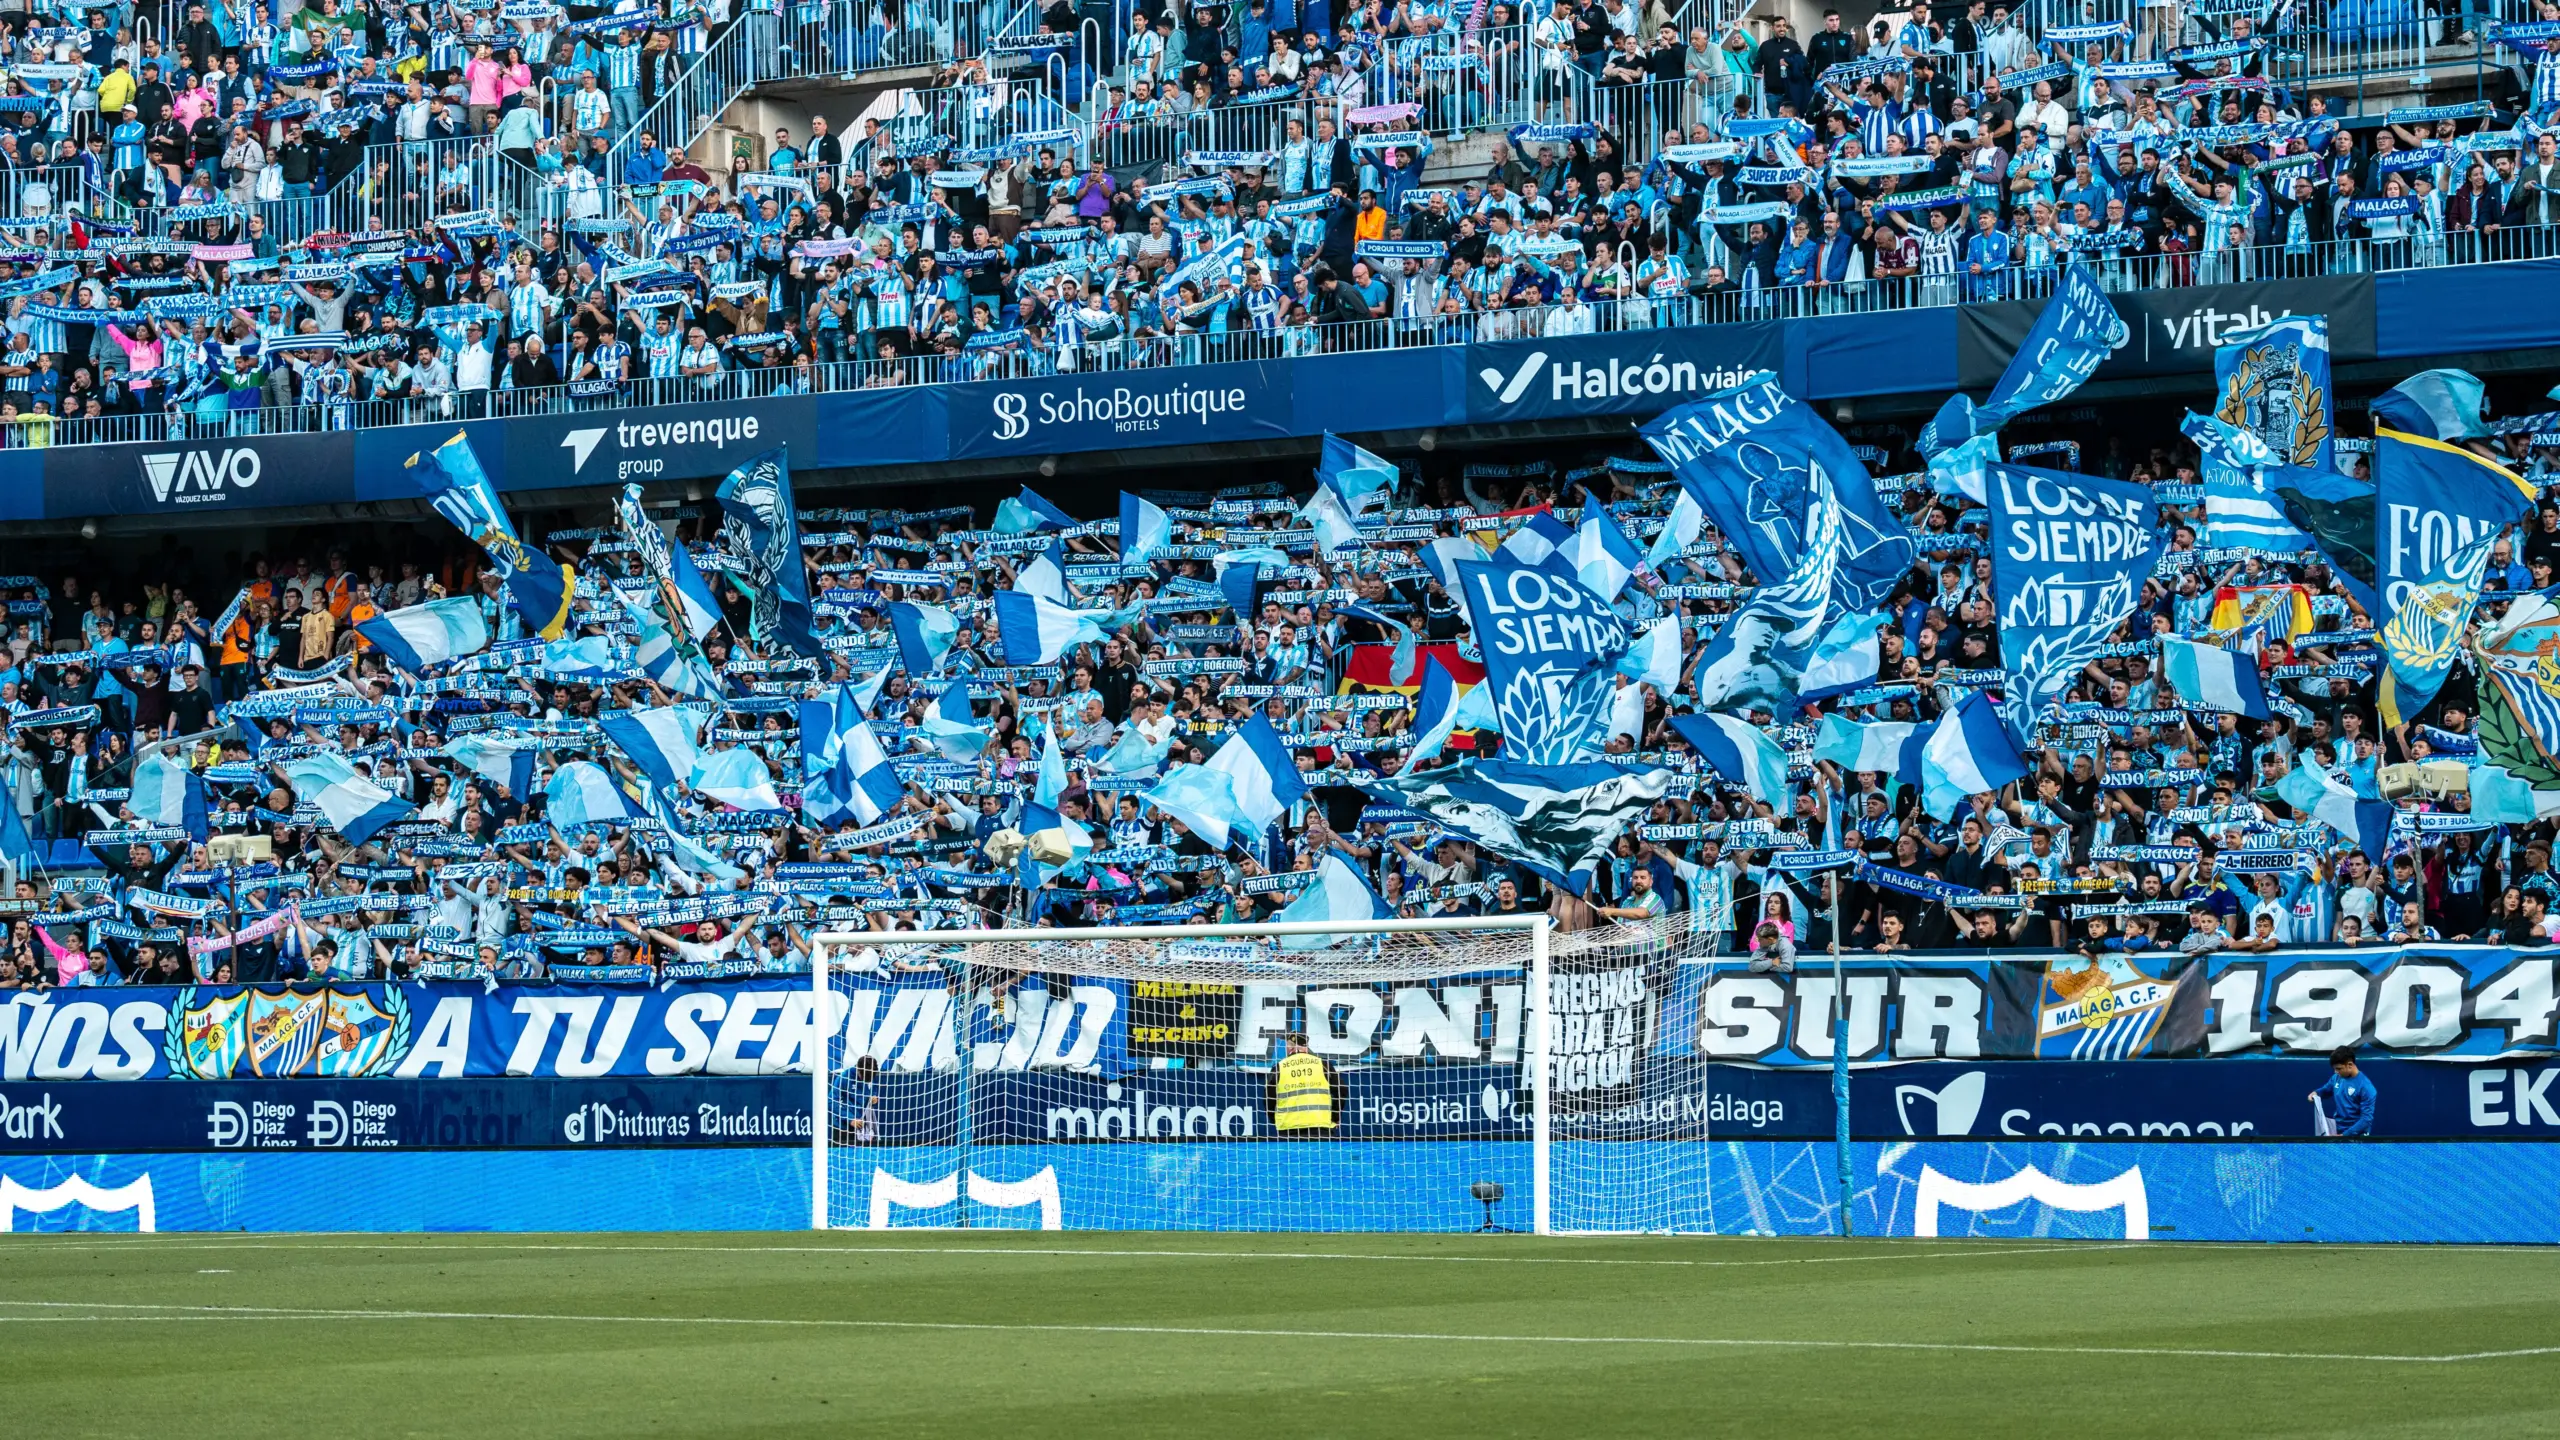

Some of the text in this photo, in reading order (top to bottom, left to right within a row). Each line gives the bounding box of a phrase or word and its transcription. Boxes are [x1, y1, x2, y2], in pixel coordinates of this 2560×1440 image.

[2057, 25, 2109, 38] MALAGA
[999, 34, 1056, 47] MALAGA
[2193, 41, 2239, 56] MALAGA
[1248, 83, 1288, 101] MALAGA
[1366, 132, 1418, 143] MALAGUISTA
[1200, 151, 1253, 162] MALAGACF
[2384, 146, 2445, 166] MALAGACF
[1749, 169, 1778, 182] SUPER
[1888, 187, 1955, 207] MALAGACF
[2355, 198, 2409, 212] MALAGA
[176, 203, 230, 219] MALAGA
[317, 234, 350, 247] MILAN
[1368, 244, 1431, 254] PORQUE TE QUIERO
[2072, 233, 2129, 250] MALAGA
[295, 265, 347, 280] MALAGA
[130, 277, 171, 287] MALAGA
[630, 291, 684, 306] MALAGACF
[738, 332, 777, 343] MALAGA
[1552, 354, 1697, 400] Halcón
[1039, 383, 1246, 425] SohoBoutique
[618, 415, 759, 449] trevenque
[1115, 419, 1160, 433] HOTELS
[618, 457, 664, 480] group
[175, 493, 226, 504] VÁZQUEZ OLMEDO
[991, 541, 1026, 553] MALAGA
[2007, 520, 2151, 563] SIEMPRE
[261, 686, 326, 702] INVENCIBLES
[717, 812, 772, 829] MALAGA
[839, 820, 915, 849] INVENCIBLES
[1642, 818, 1766, 841] FONDO SUR
[1785, 849, 1853, 865] PORQUE TE QUIERO
[2238, 853, 2294, 869] HERRERO
[382, 868, 413, 879] NOSOTROS
[1881, 871, 1923, 892] MALAGA
[148, 893, 200, 912] MALAGA
[361, 895, 400, 910] PADRES
[656, 908, 705, 925] PADRES
[557, 930, 615, 943] MALAGA
[423, 939, 475, 958] FONDO
[2055, 984, 2162, 1025] MALAGA C.F.
[2207, 958, 2560, 1054] 1904
[1700, 976, 1984, 1058] SUR
[396, 996, 473, 1078] A
[510, 996, 643, 1078] TU
[1133, 1023, 1229, 1043] TECHNO
[1282, 1057, 1320, 1068] SEGURIDAD
[1290, 1068, 1313, 1078] 0019
[252, 1101, 296, 1121] Diego
[352, 1100, 397, 1120] Diego
[1359, 1096, 1471, 1130] Hospital
[1684, 1092, 1784, 1128] Málaga
[252, 1117, 286, 1136] Díaz
[352, 1117, 386, 1136] Díaz
[590, 1101, 813, 1138] Pinturas Andalucía
